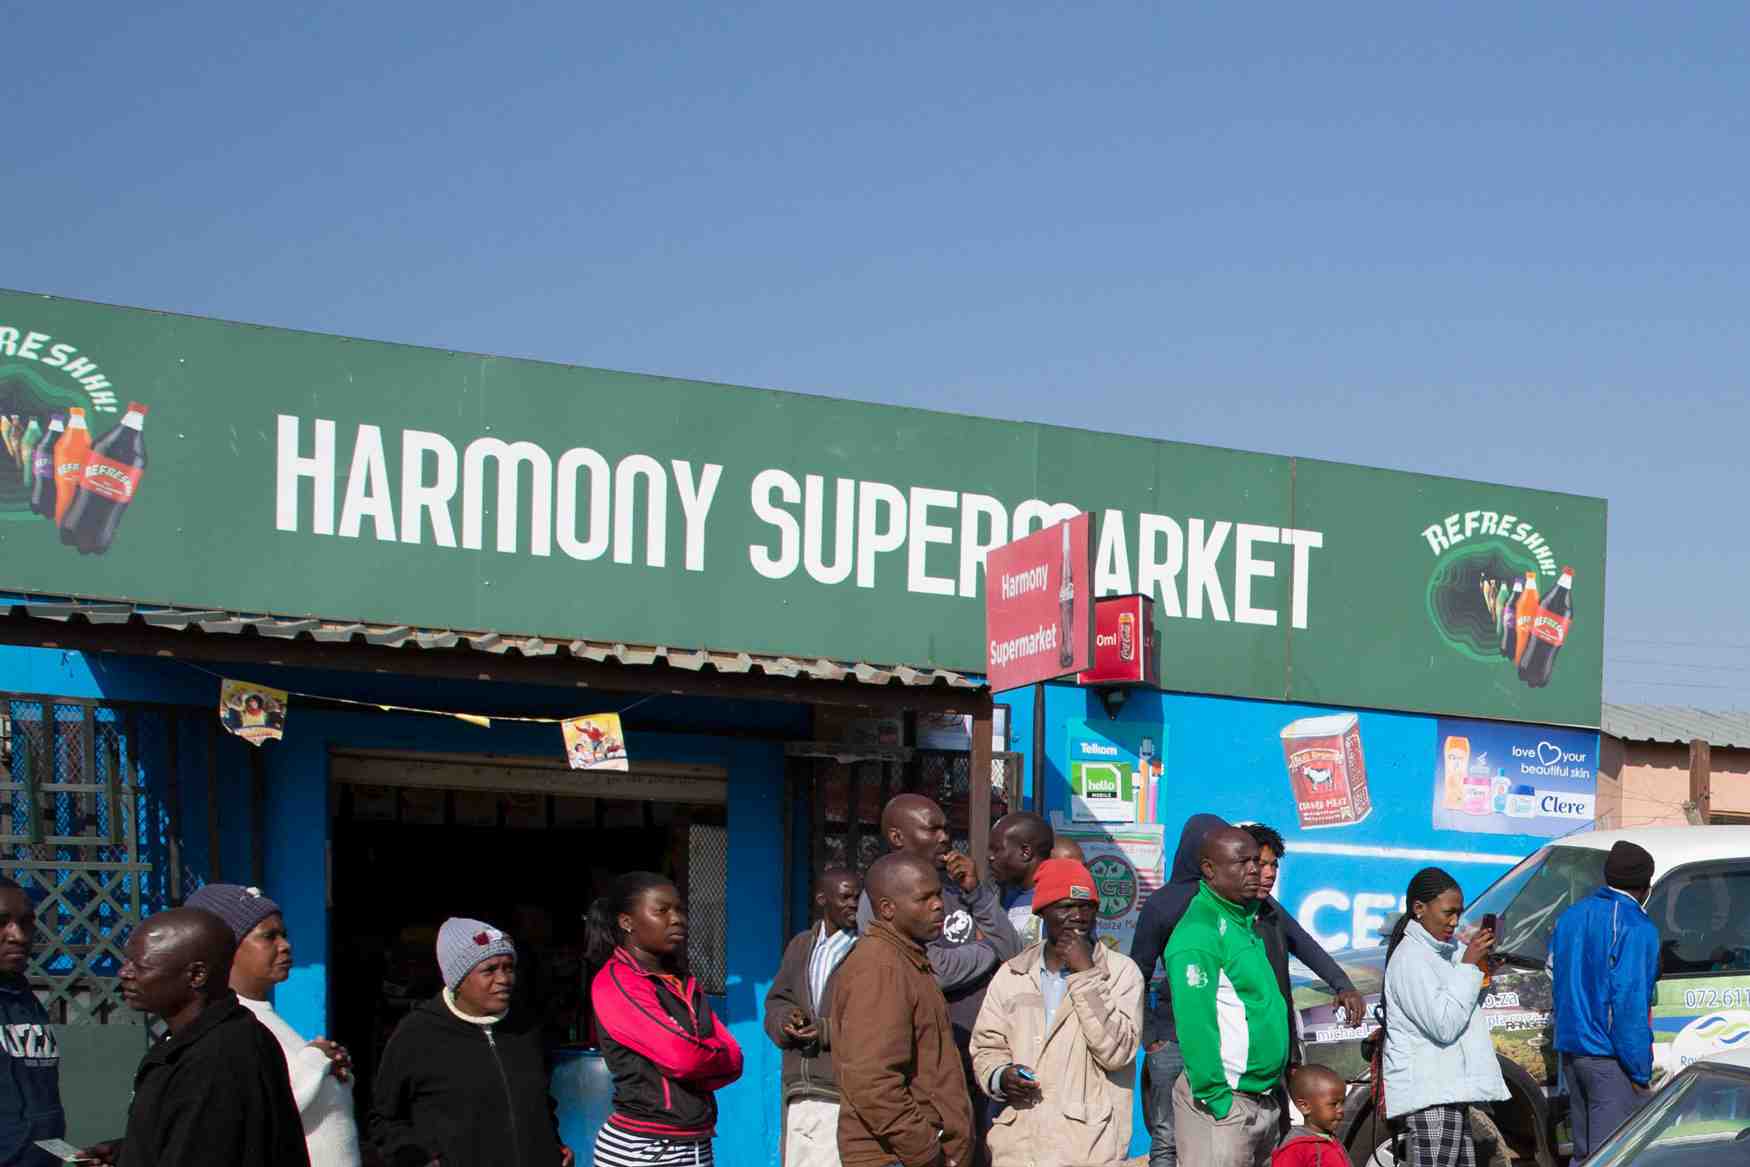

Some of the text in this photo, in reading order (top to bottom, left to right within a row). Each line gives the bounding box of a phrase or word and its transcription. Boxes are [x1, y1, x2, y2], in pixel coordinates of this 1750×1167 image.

[275, 413, 724, 572] HARMONY
[1001, 562, 1049, 601] Harmony
[990, 623, 1057, 668] Supermarket
[1079, 741, 1118, 756] Telkom
[1512, 745, 1587, 763] love your
[1520, 763, 1591, 780] beautiful skin
[1087, 779, 1116, 791] hello
[1541, 795, 1586, 816] Clere
[1300, 890, 1408, 953] CE
